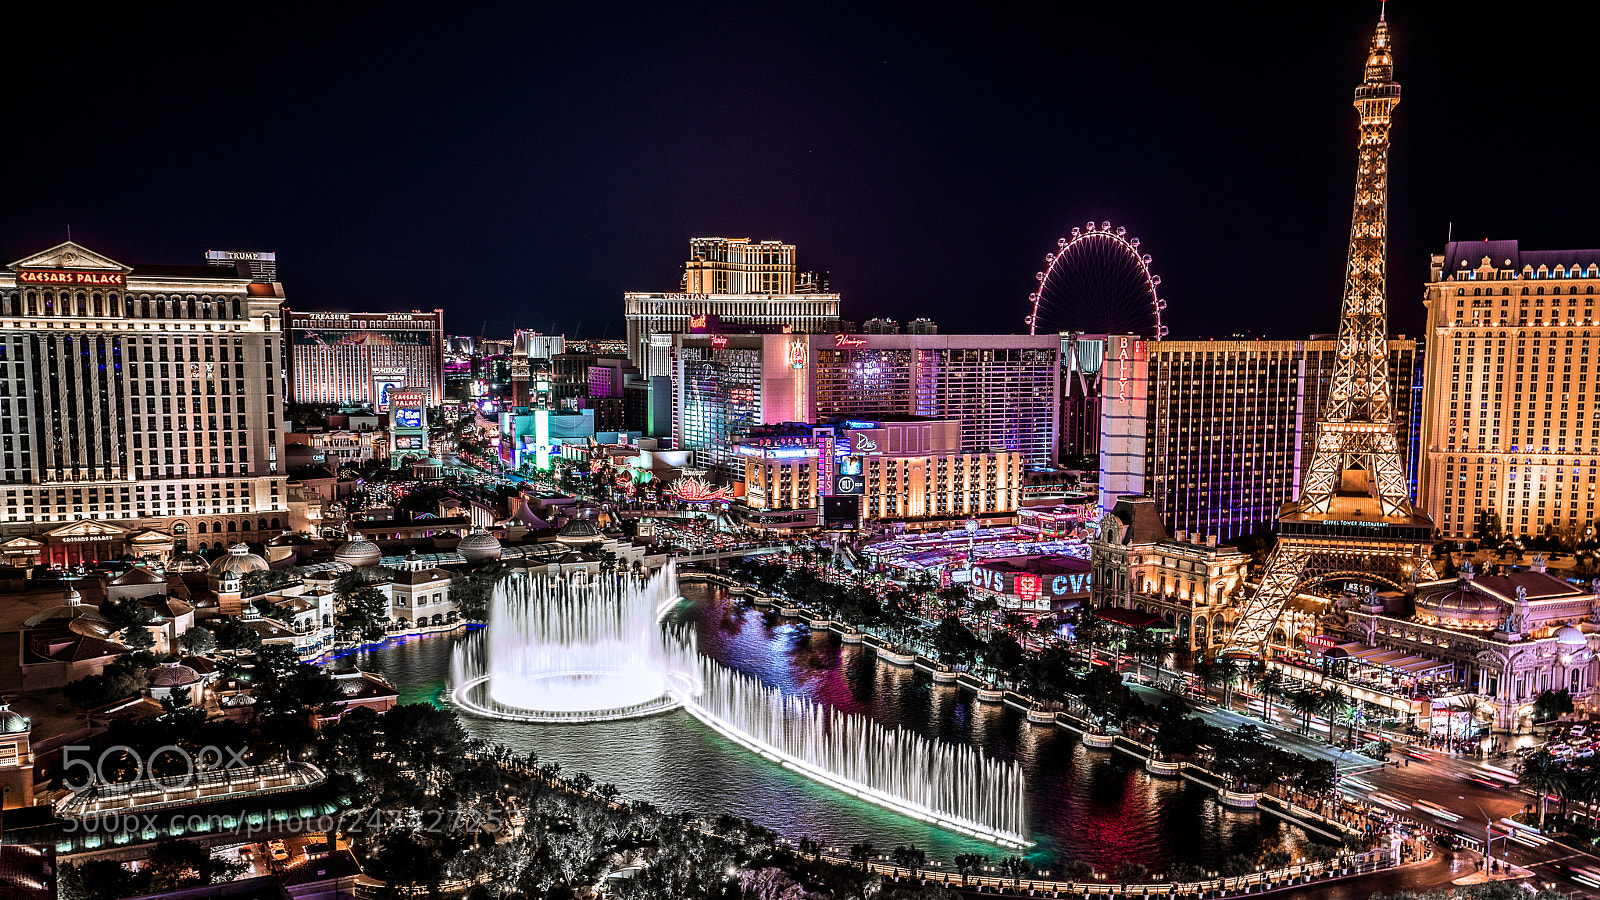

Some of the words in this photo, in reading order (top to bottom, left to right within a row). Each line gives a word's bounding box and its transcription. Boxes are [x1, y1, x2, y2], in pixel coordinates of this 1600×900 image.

[20, 272, 73, 282] CAESARS
[76, 273, 122, 284] PALACE
[1118, 338, 1128, 404] BALLYS
[825, 440, 833, 490] BALLYS
[972, 566, 1004, 592] CVS
[1305, 636, 1318, 644] BEER
[1320, 638, 1335, 648] PARK
